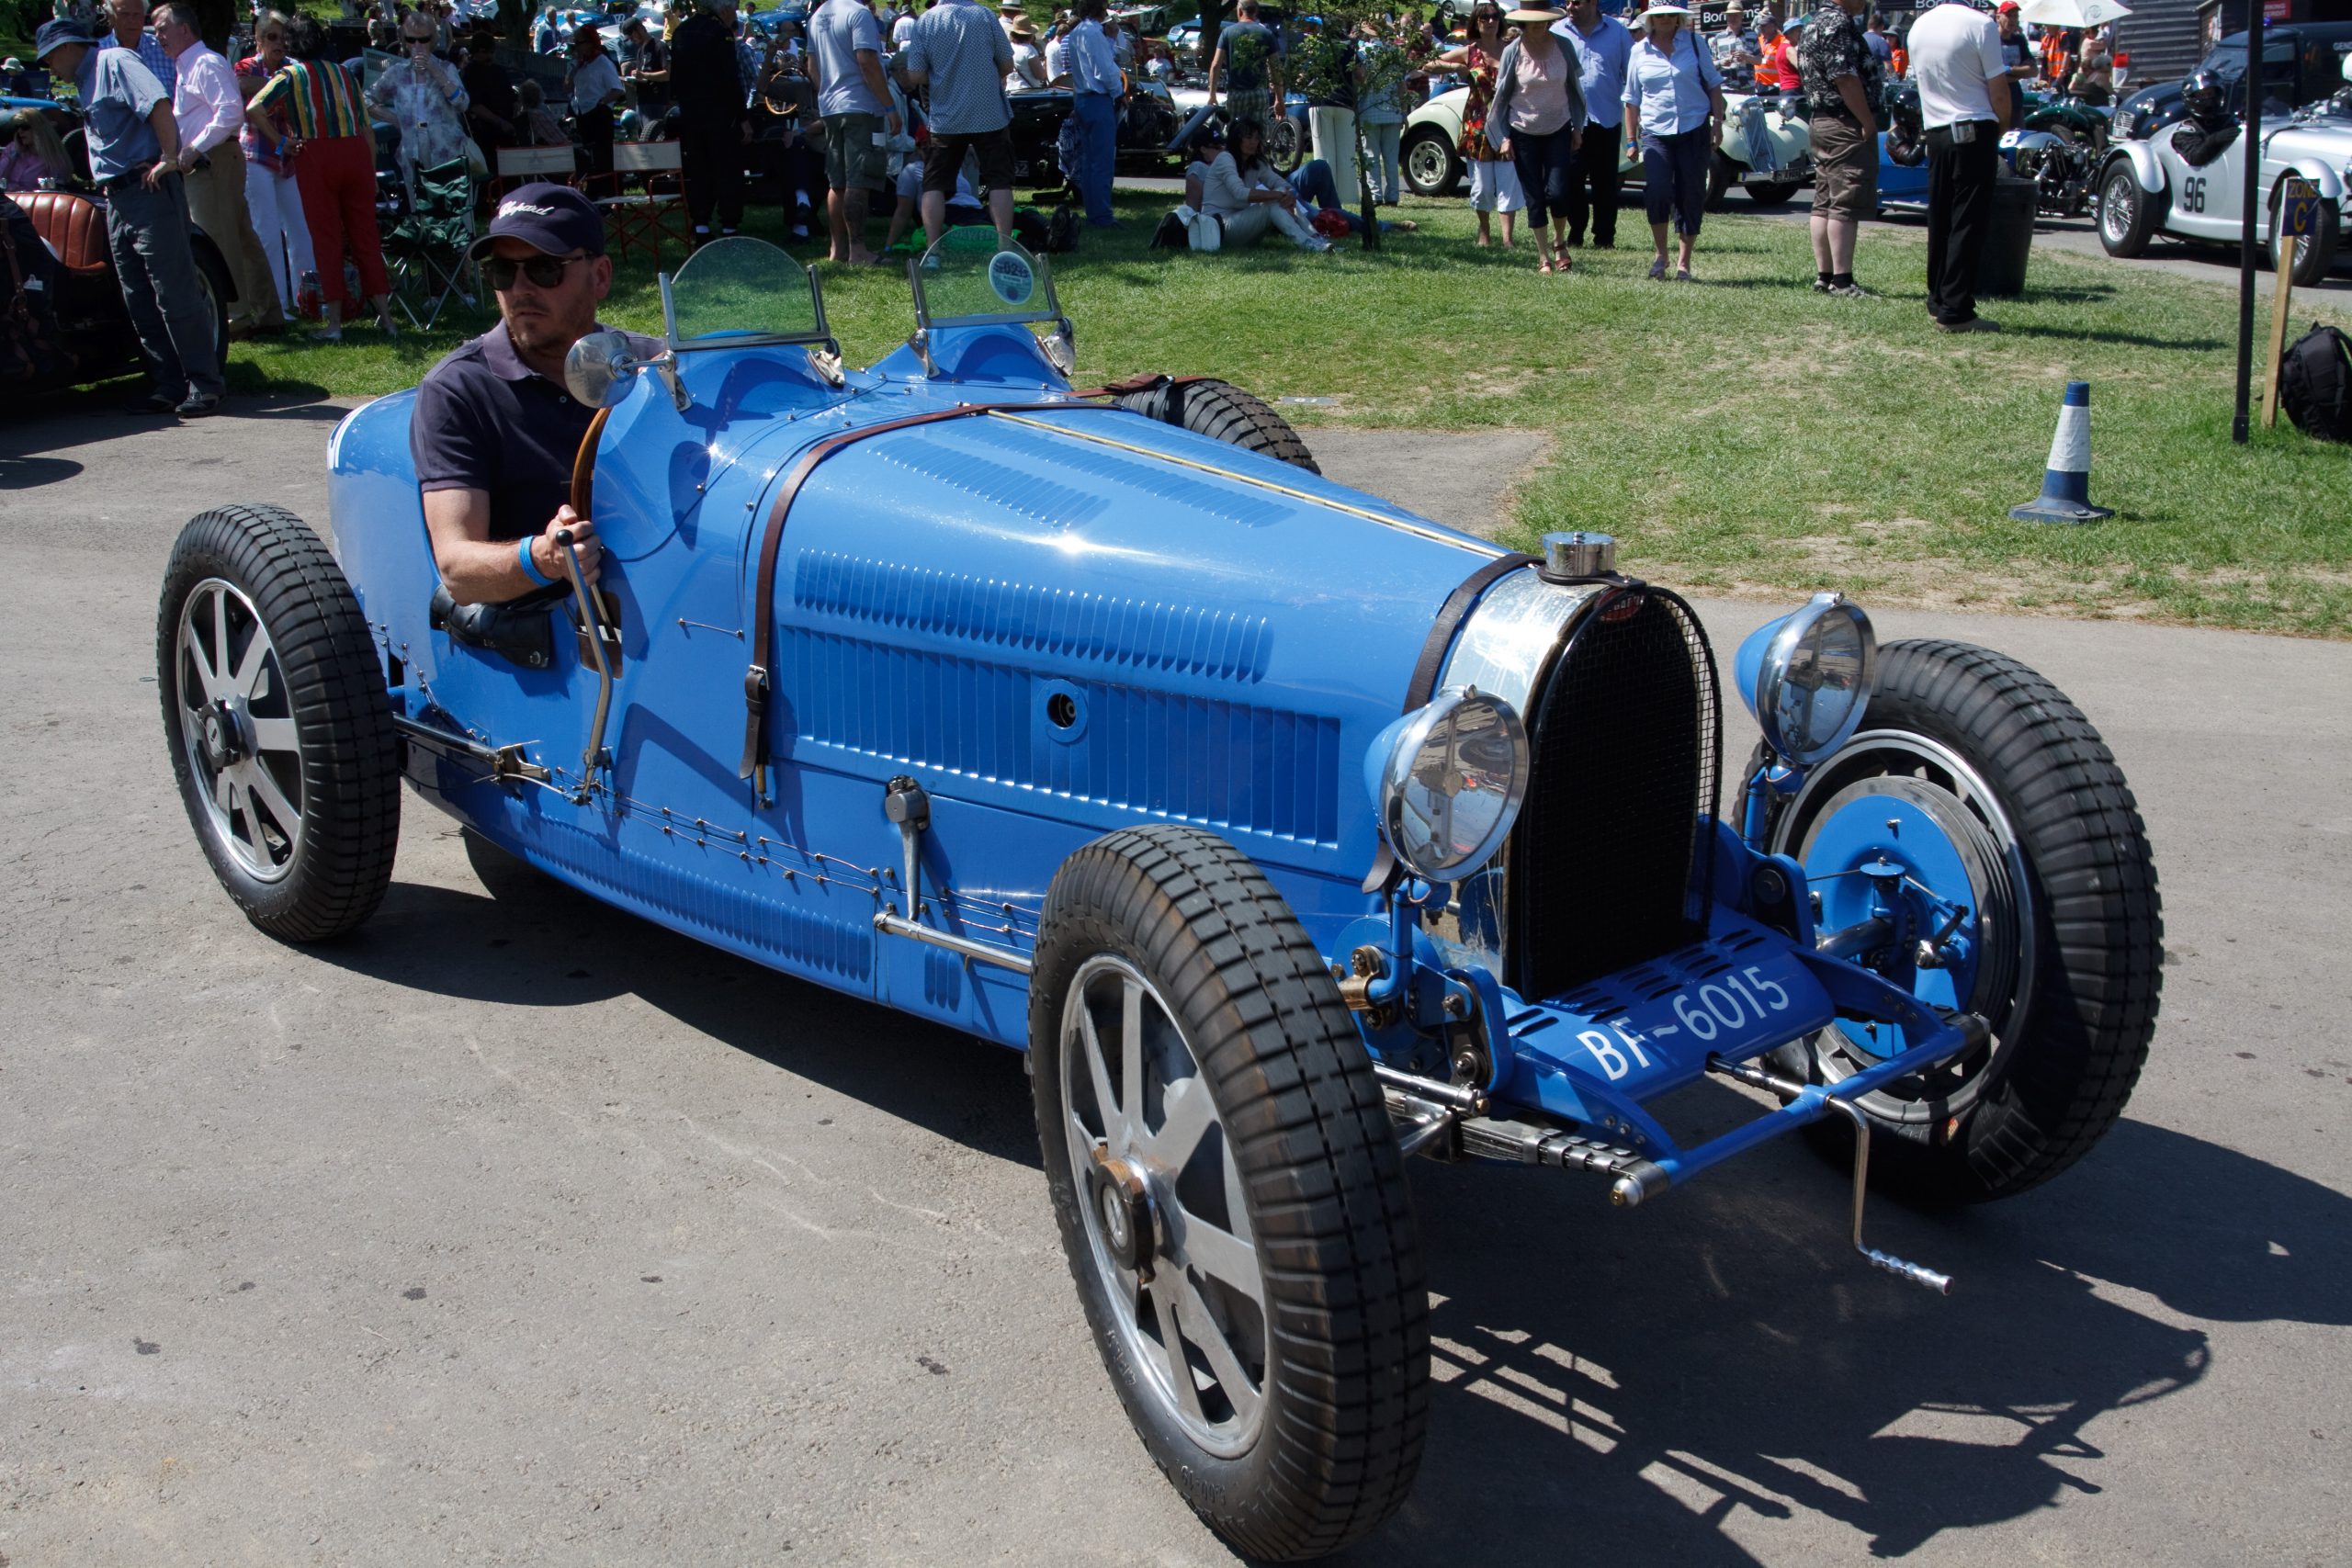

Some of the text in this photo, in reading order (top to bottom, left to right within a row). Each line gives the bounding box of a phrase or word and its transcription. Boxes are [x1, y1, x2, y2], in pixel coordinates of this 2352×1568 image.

[1703, 8, 1761, 23] Bonms
[2184, 176, 2207, 213] 96
[2288, 182, 2320, 198] ZONE
[2294, 202, 2307, 232] C
